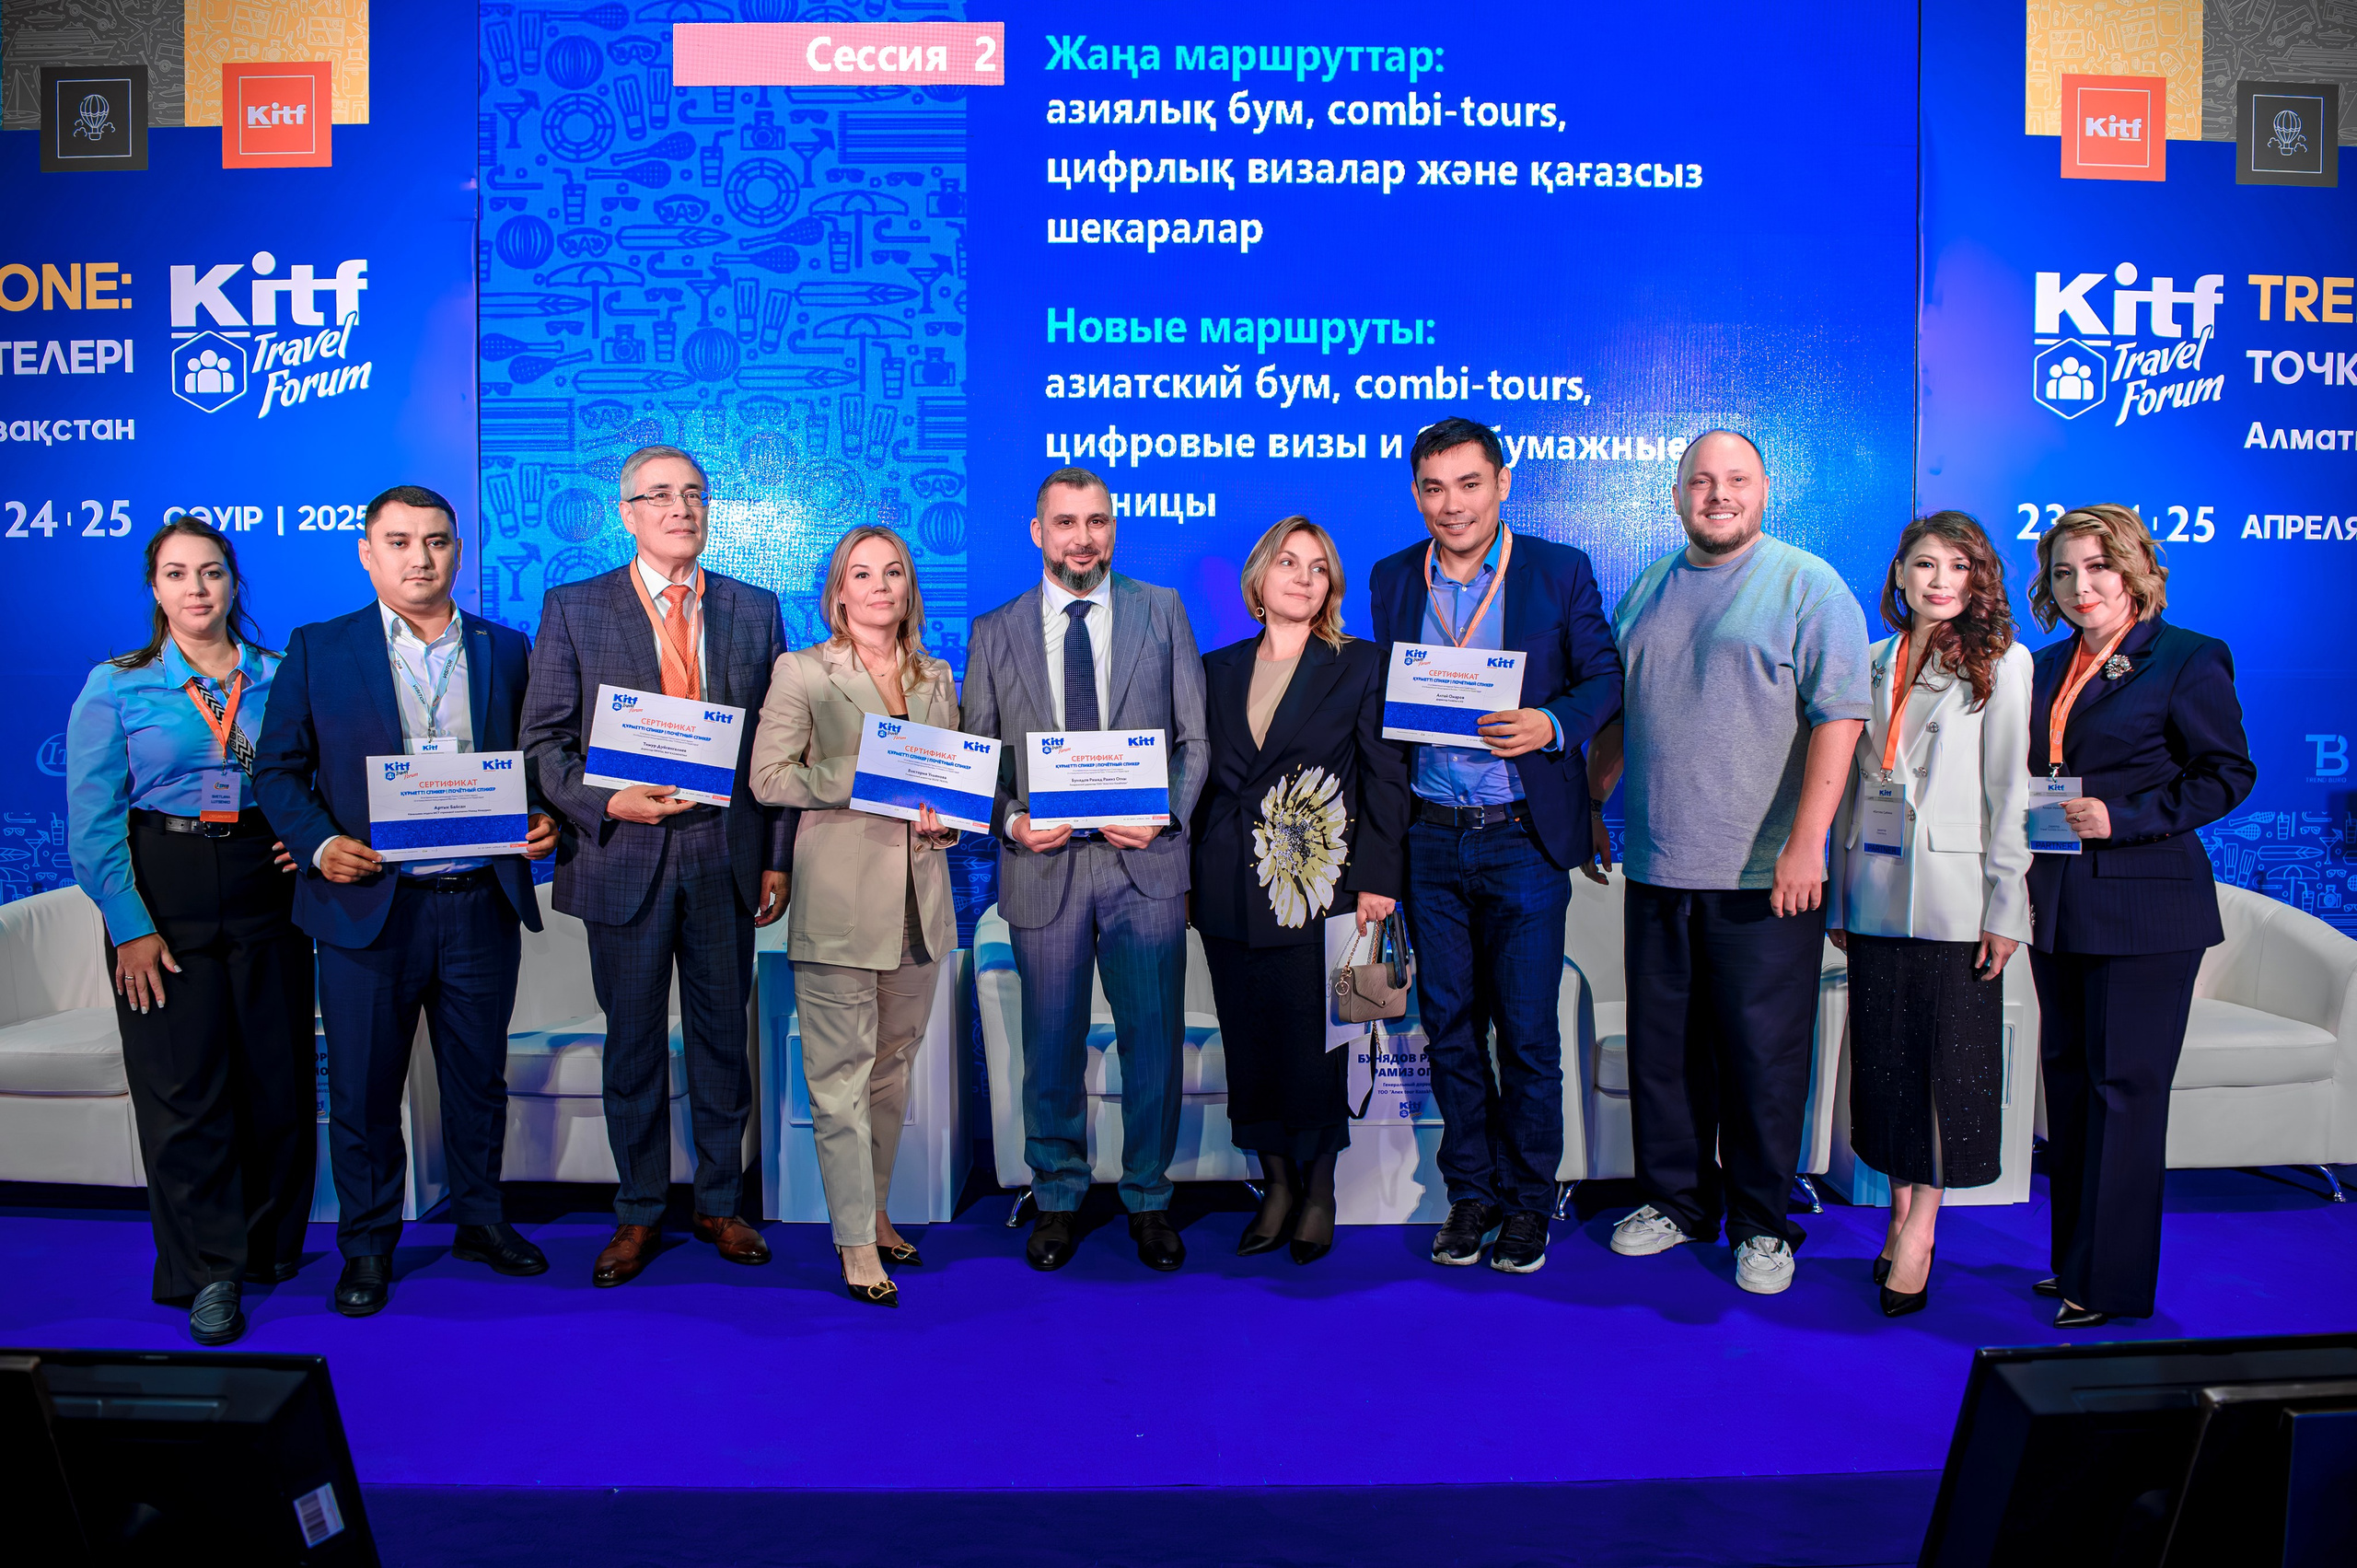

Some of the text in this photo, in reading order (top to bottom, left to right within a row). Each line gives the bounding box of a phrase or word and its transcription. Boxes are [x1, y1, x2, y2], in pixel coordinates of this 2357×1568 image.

[807, 36, 996, 73] Сессия 2
[1045, 35, 1444, 83] Жаңа маршруттар:
[247, 101, 307, 125] Kitf
[1046, 89, 1567, 134] азиялық бум, combi-tours,
[2084, 114, 2142, 139] Kitf
[1047, 149, 1703, 194] цифрлық визалар және қағазсыз
[1047, 218, 1263, 254] шекаралар
[0, 262, 132, 312] ONE:
[170, 250, 368, 327] Kitf
[2034, 261, 2224, 339] Kitf
[251, 310, 354, 374] Travel
[1047, 308, 1435, 355] Новые маршруты:
[2110, 325, 2212, 382] Travel
[258, 361, 373, 419] Forum
[1046, 364, 1592, 409] азиатский бум, combi-tours,
[2115, 374, 2225, 427] Forum
[1046, 424, 1688, 469] цифровые визы и умажные
[2244, 422, 2357, 451] Алмат
[6, 499, 132, 538] 24 25
[1110, 493, 1216, 525] ницы
[2166, 505, 2215, 543] 25
[2241, 514, 2357, 540] АПРЕЛЯ
[1405, 649, 1428, 659] Kitf
[1487, 657, 1515, 669] Kitf
[443, 659, 454, 679] VISITOR
[1428, 669, 1480, 680] СЕРТИФИКАТ
[612, 693, 638, 705] Kitf
[641, 718, 697, 733] СЕРТИФИКАТ
[703, 711, 734, 725] Kitf
[878, 721, 901, 733] Kitf
[904, 745, 957, 761] СЕРТИФИКАТ
[963, 740, 991, 754] Kitf
[1041, 737, 1064, 746] Kitf
[1128, 736, 1155, 747] Kitf
[385, 761, 411, 772] Kitf
[482, 759, 513, 771] Kitf
[1071, 754, 1124, 762] СЕРТИФИКАТ
[419, 779, 479, 789] СЕРТИФИКАТ
[2036, 842, 2073, 850] PARTNER
[1399, 1100, 1422, 1109] Kitf
